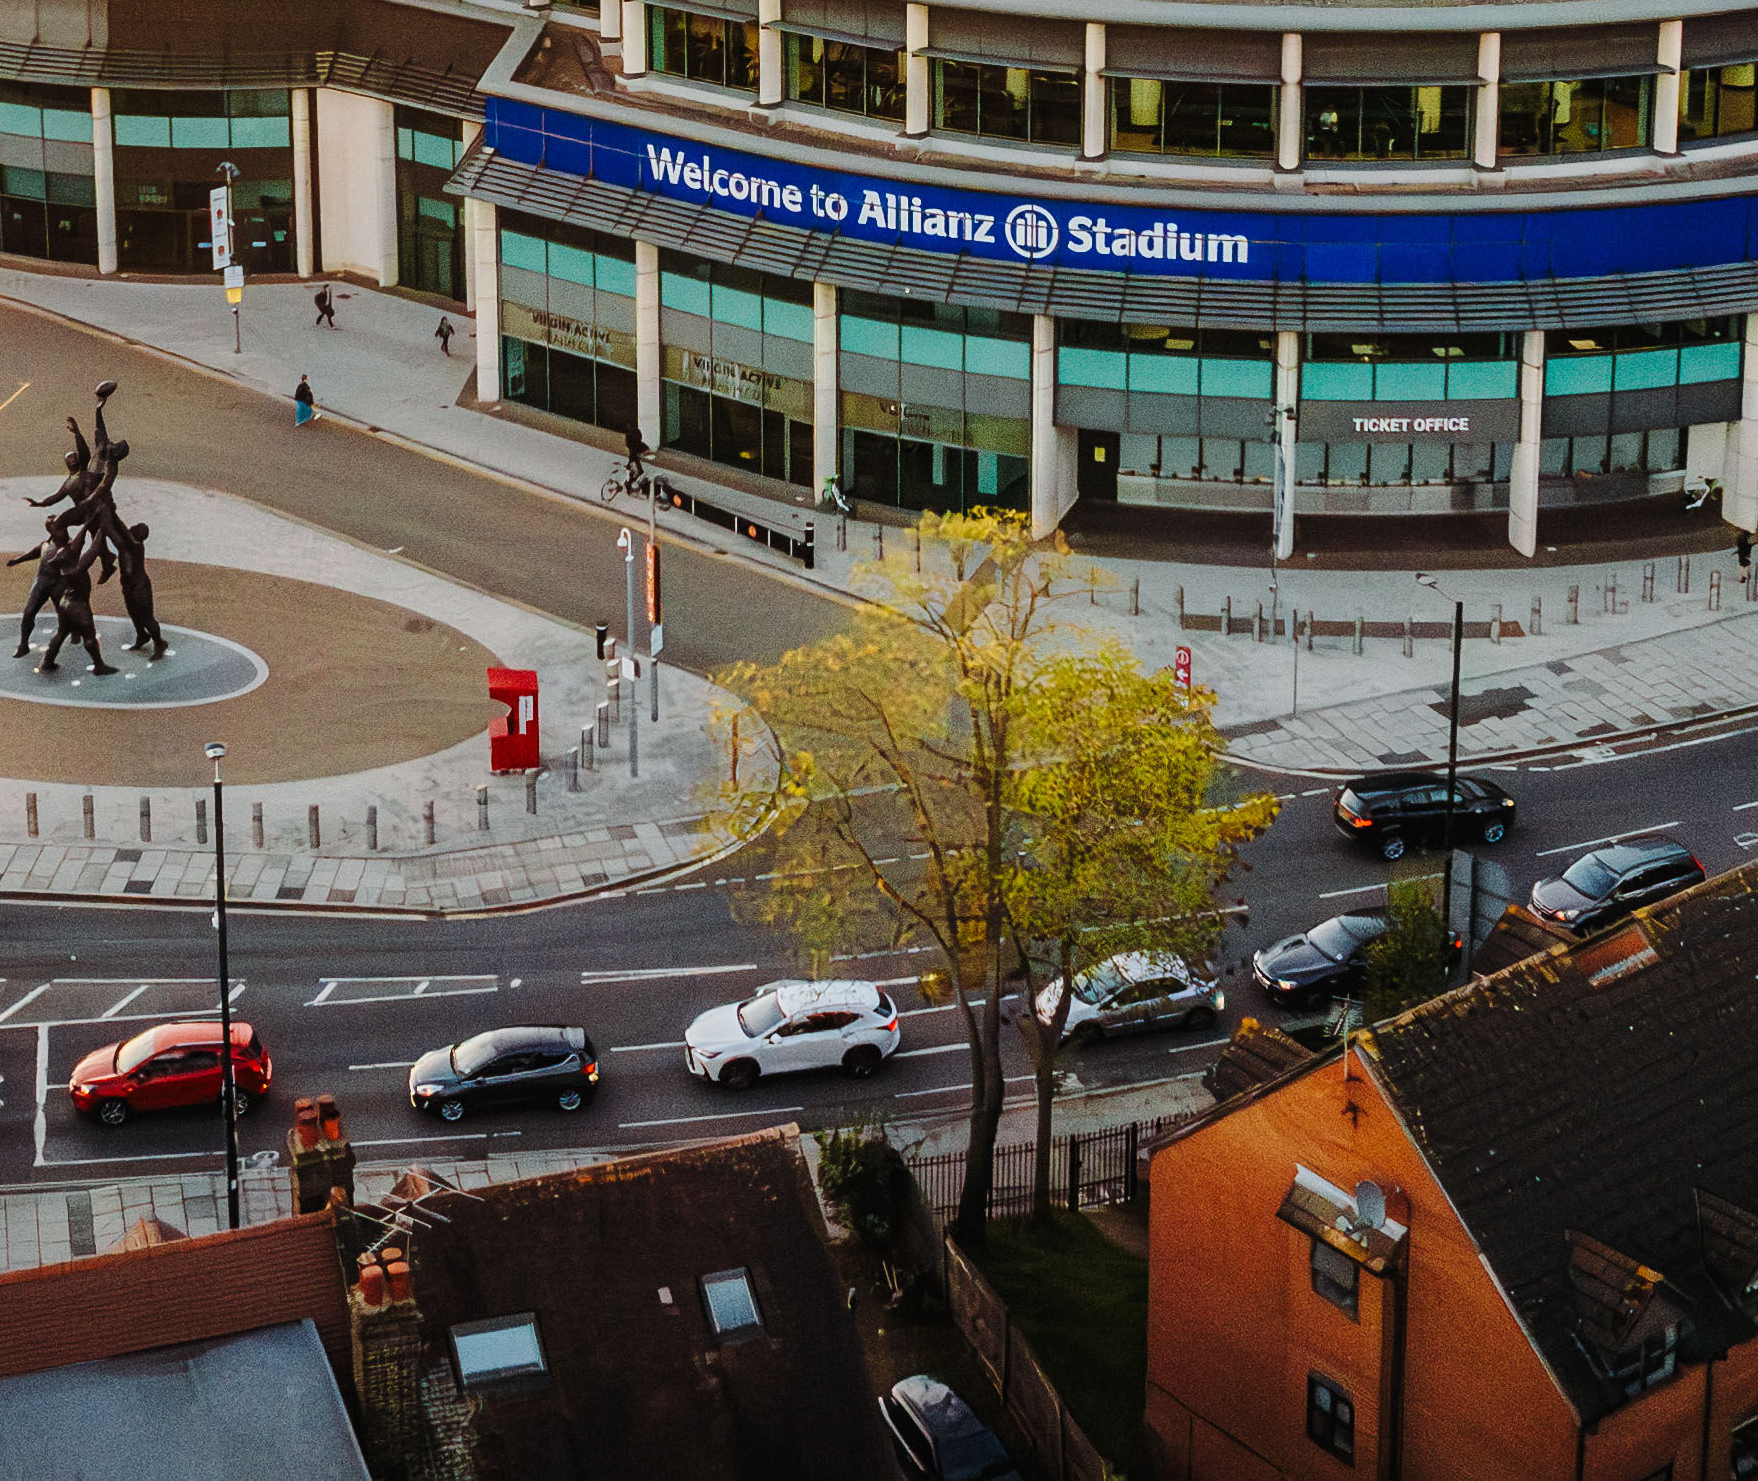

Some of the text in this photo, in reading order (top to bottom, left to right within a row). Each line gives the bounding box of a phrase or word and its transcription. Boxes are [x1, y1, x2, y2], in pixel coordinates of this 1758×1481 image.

[647, 144, 1248, 264] Welcome to Allianz Stadium
[1352, 417, 1469, 432] TICKET OFFICE
